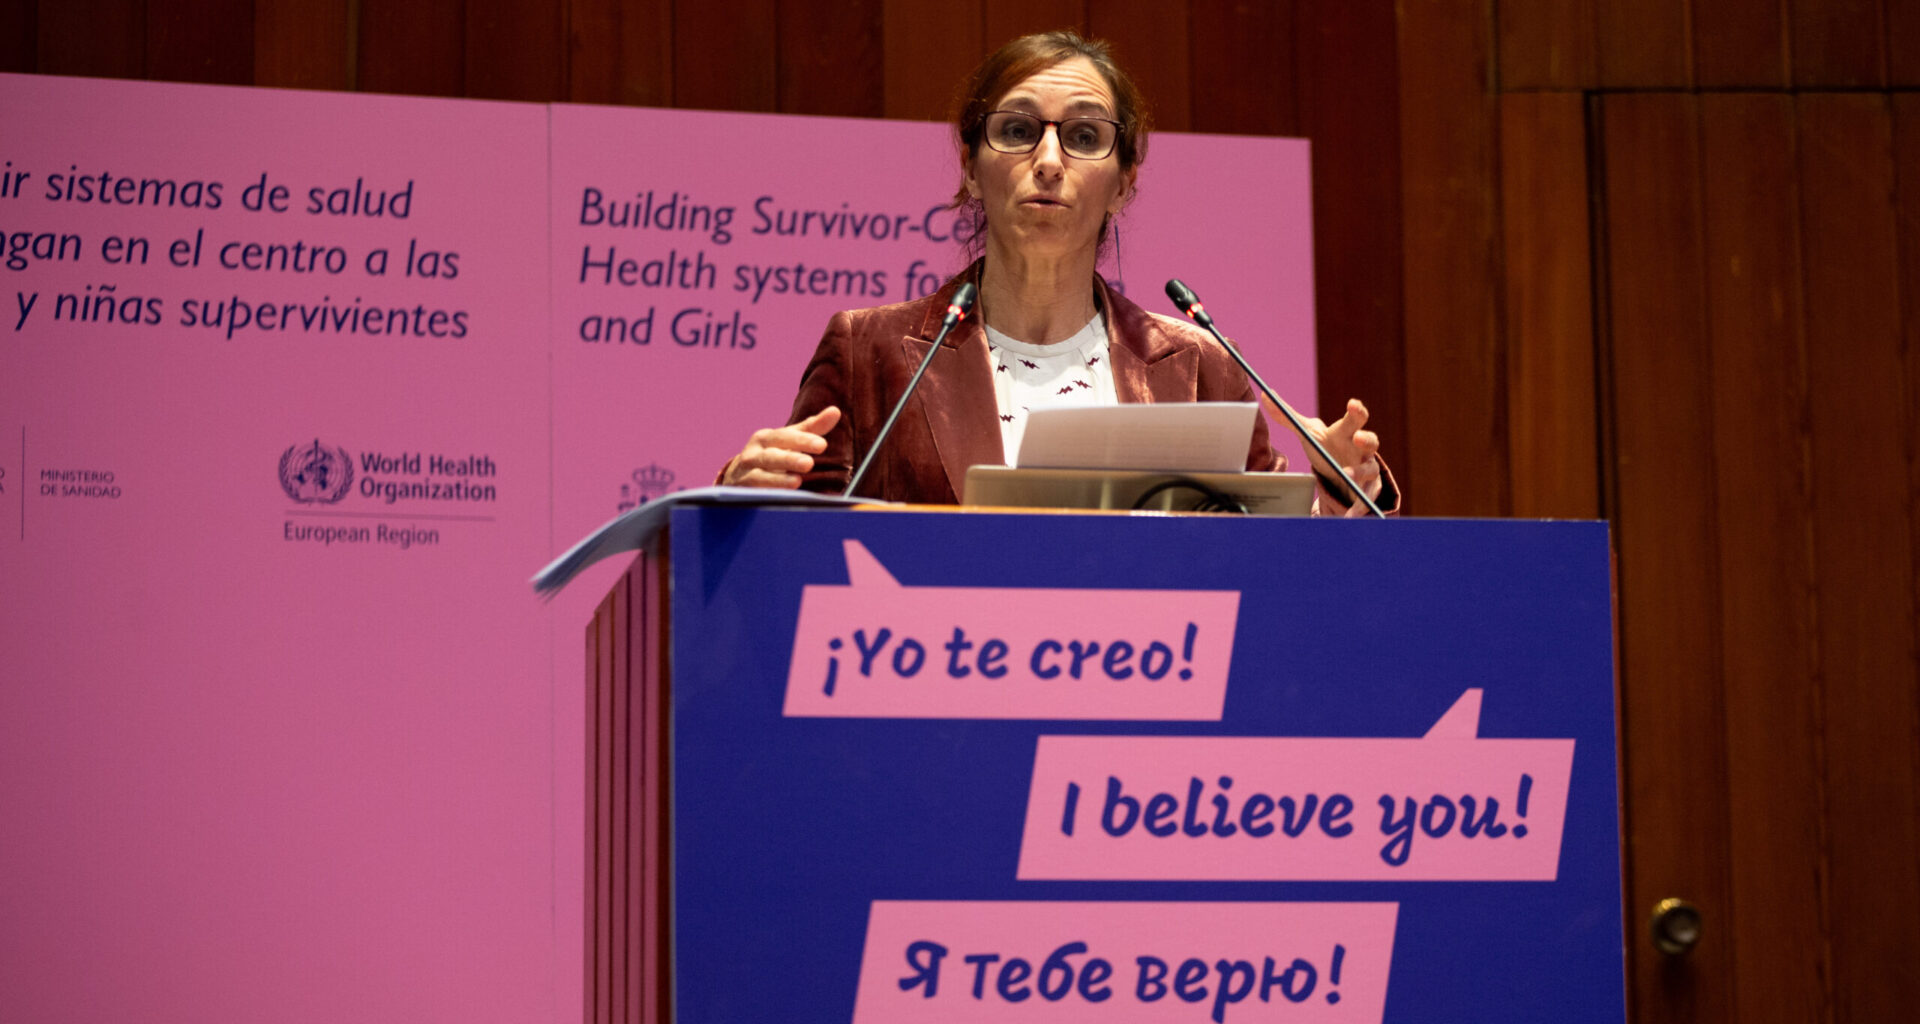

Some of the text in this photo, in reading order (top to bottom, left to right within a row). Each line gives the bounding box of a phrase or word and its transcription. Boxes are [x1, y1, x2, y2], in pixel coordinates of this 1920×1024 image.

[1, 161, 414, 220] ir sistemas de salud
[579, 186, 736, 246] Building
[0, 228, 461, 280] gan en el centro a las
[579, 244, 955, 305] Health systems fo
[14, 283, 470, 341] y niñas supervivientes
[579, 306, 757, 350] and Girls
[40, 469, 115, 484] MINISTERIO
[40, 484, 122, 499] DE SANIDAD
[360, 452, 496, 477] World Health
[360, 476, 496, 504] Organization
[284, 521, 440, 549] European Region
[821, 621, 1199, 698] ¡Yo te creo!
[1060, 772, 1535, 868] I believe you!
[897, 939, 1347, 1024] Я тебе верю!
